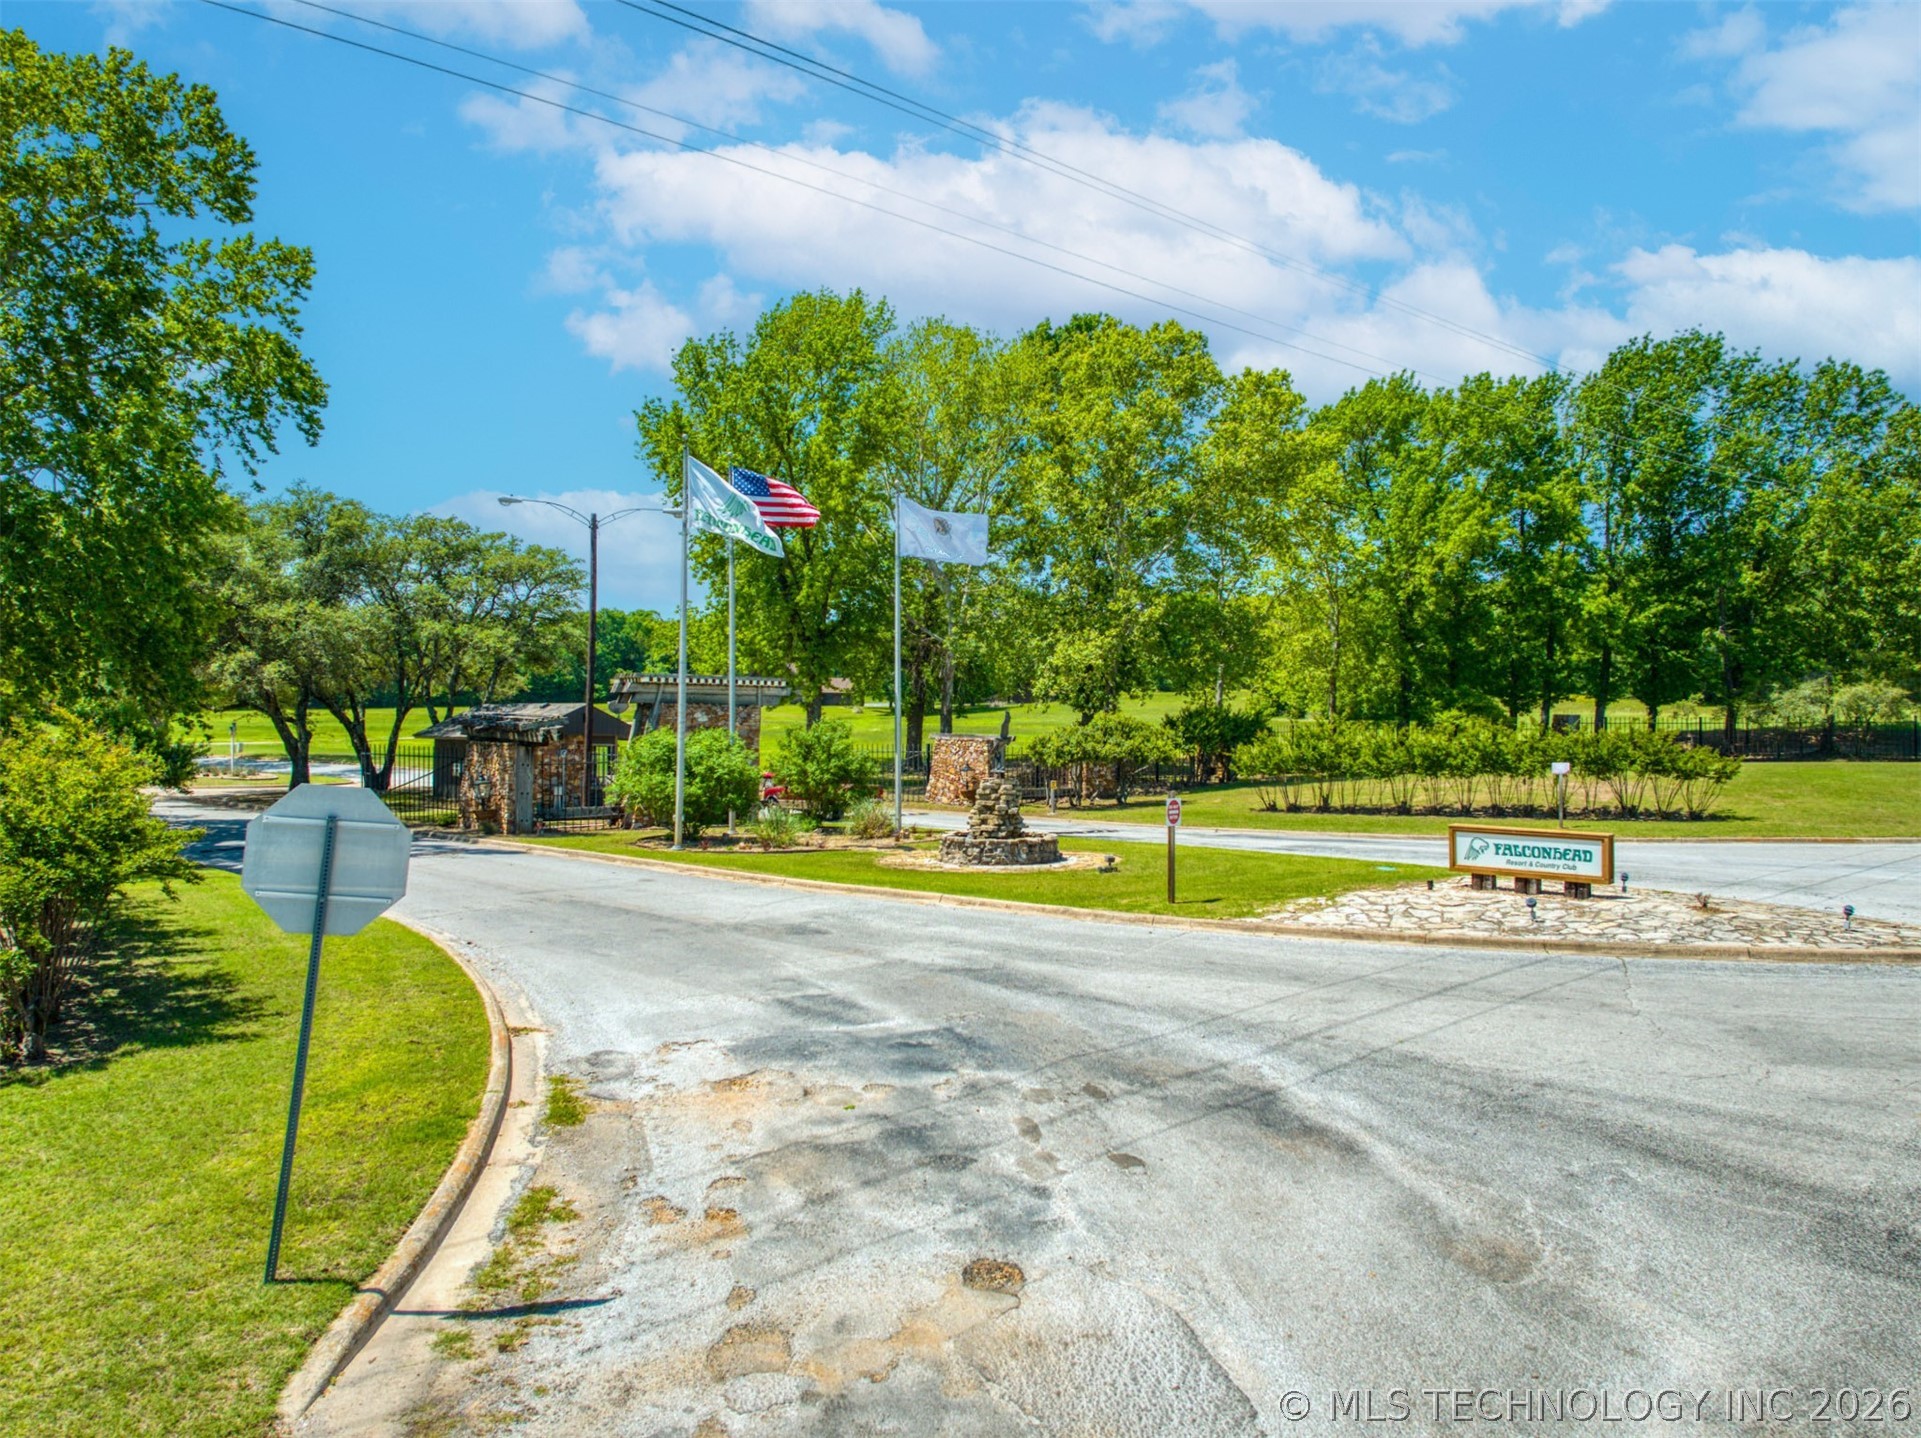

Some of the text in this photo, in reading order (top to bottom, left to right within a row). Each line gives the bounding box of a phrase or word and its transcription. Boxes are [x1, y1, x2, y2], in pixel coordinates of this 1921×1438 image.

[1506, 859, 1527, 867] Resort
[1535, 861, 1561, 870] Country
[1562, 863, 1577, 871] Club
